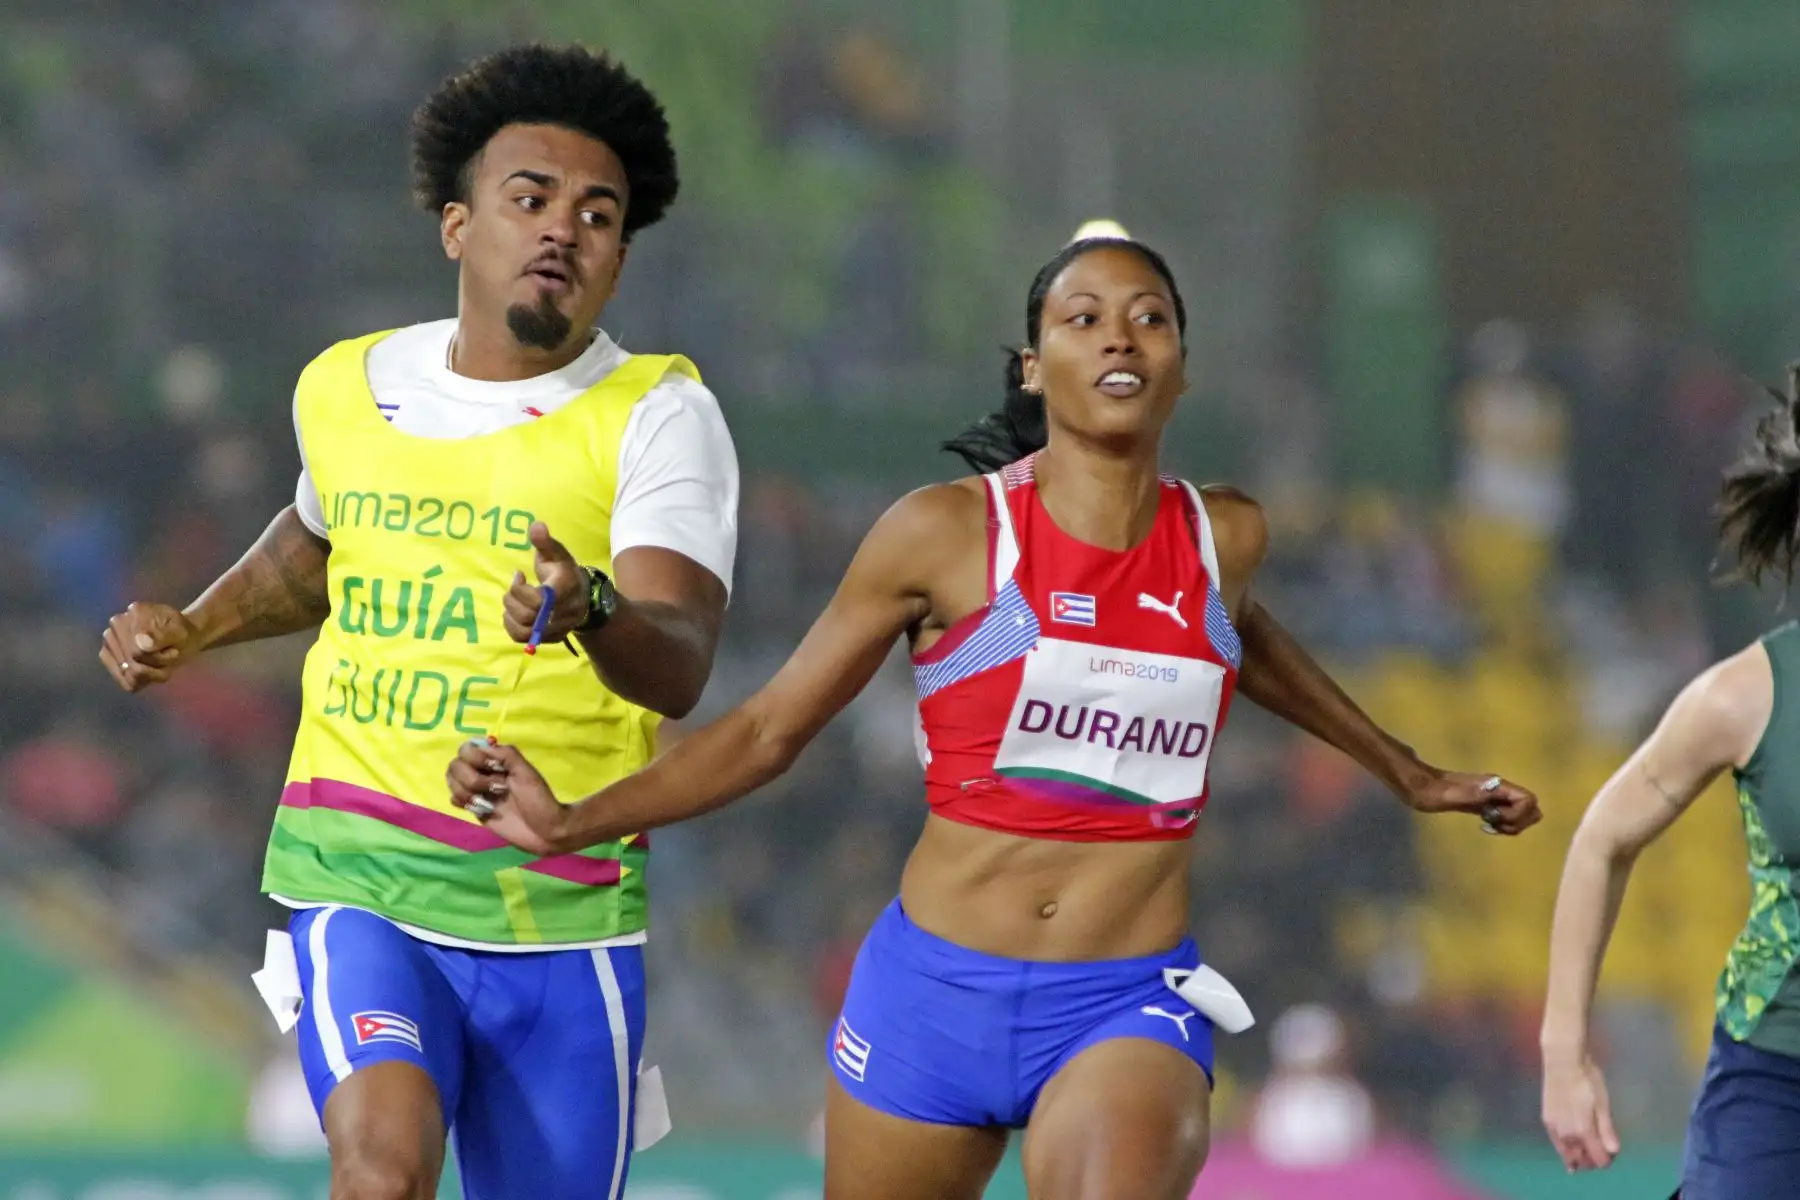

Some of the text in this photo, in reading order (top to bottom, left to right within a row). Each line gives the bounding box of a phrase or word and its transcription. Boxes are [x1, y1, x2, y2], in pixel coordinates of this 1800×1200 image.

[338, 564, 479, 643] GUÍA
[323, 658, 499, 735] GUIDE
[1018, 699, 1209, 758] DURAND
